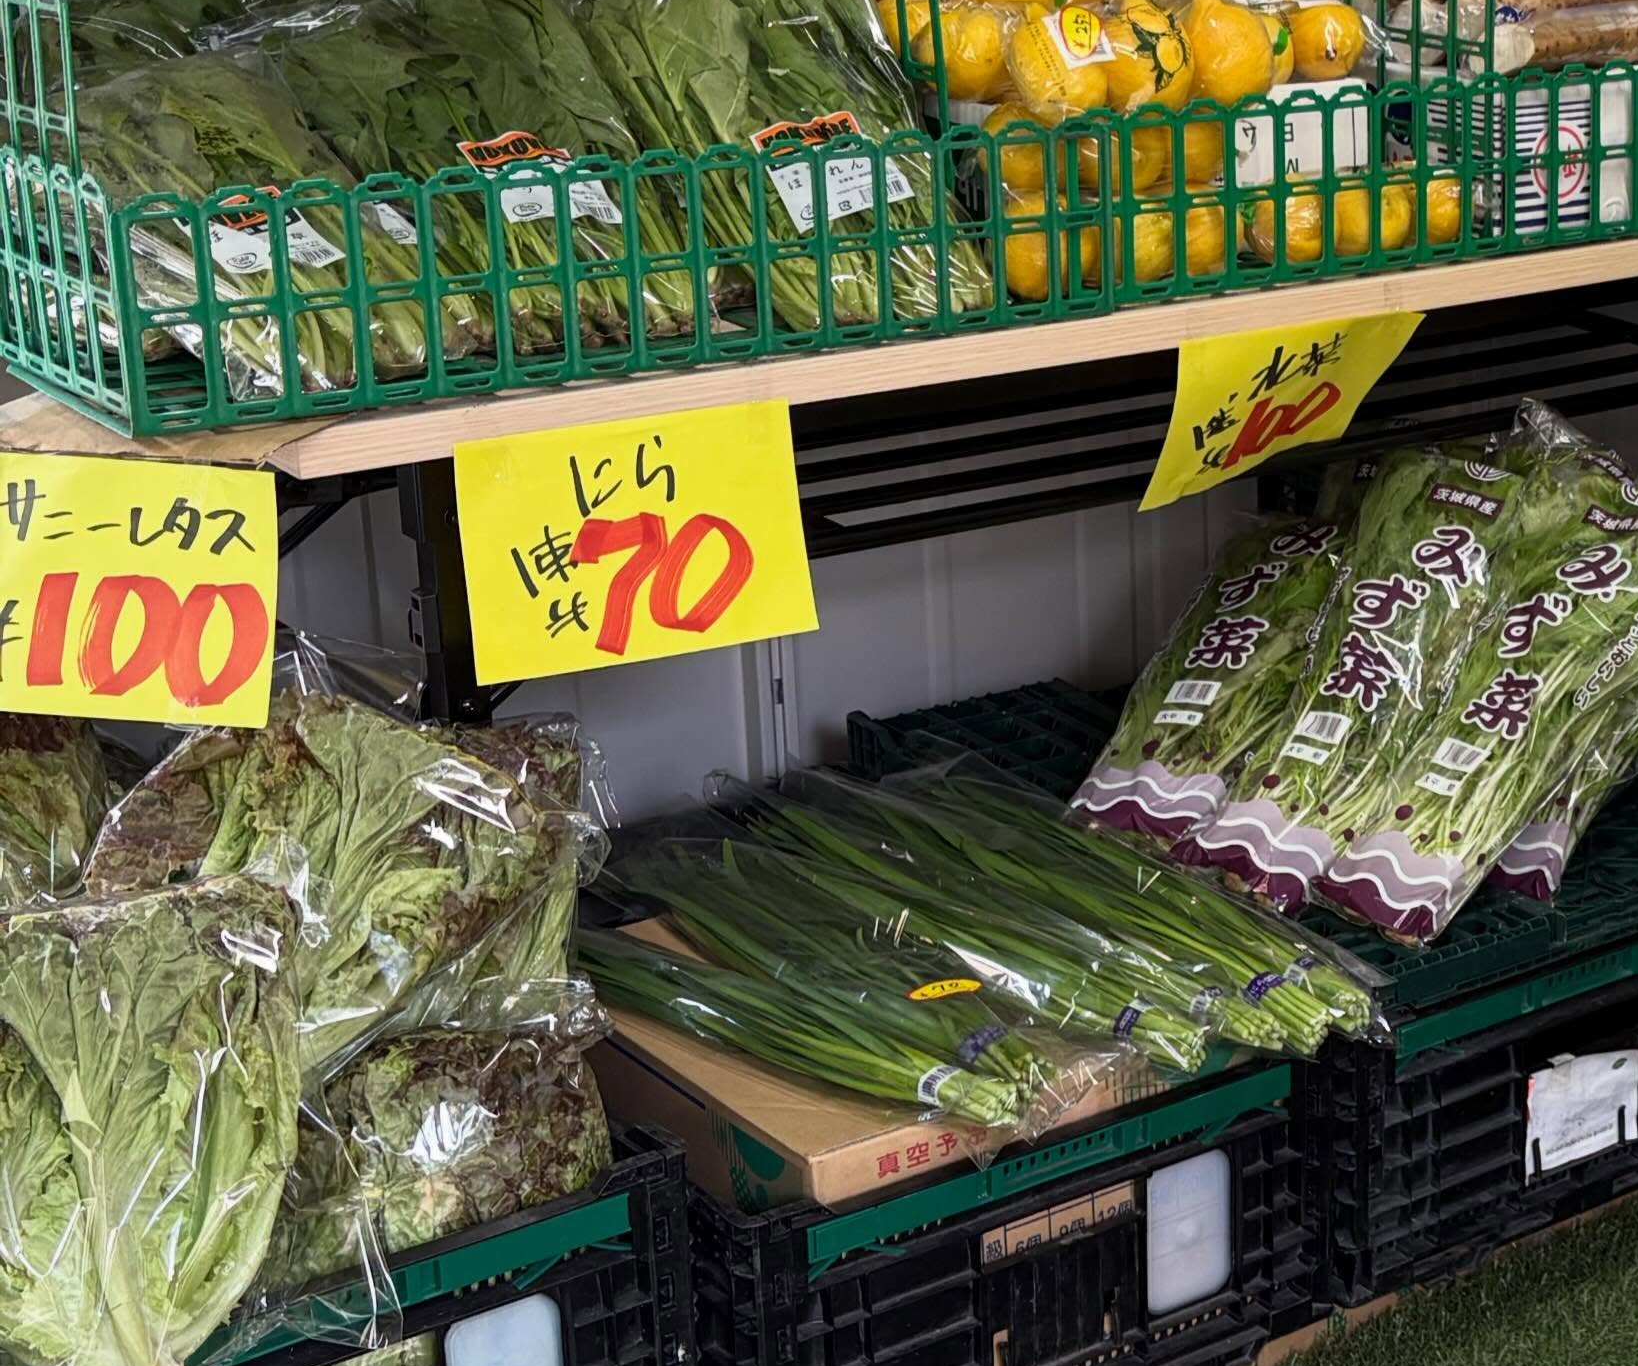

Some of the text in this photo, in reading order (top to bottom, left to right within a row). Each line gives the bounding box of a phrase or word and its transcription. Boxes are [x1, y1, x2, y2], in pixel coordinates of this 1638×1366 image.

[0, 478, 256, 556] サニーレタス
[569, 435, 675, 519] にら
